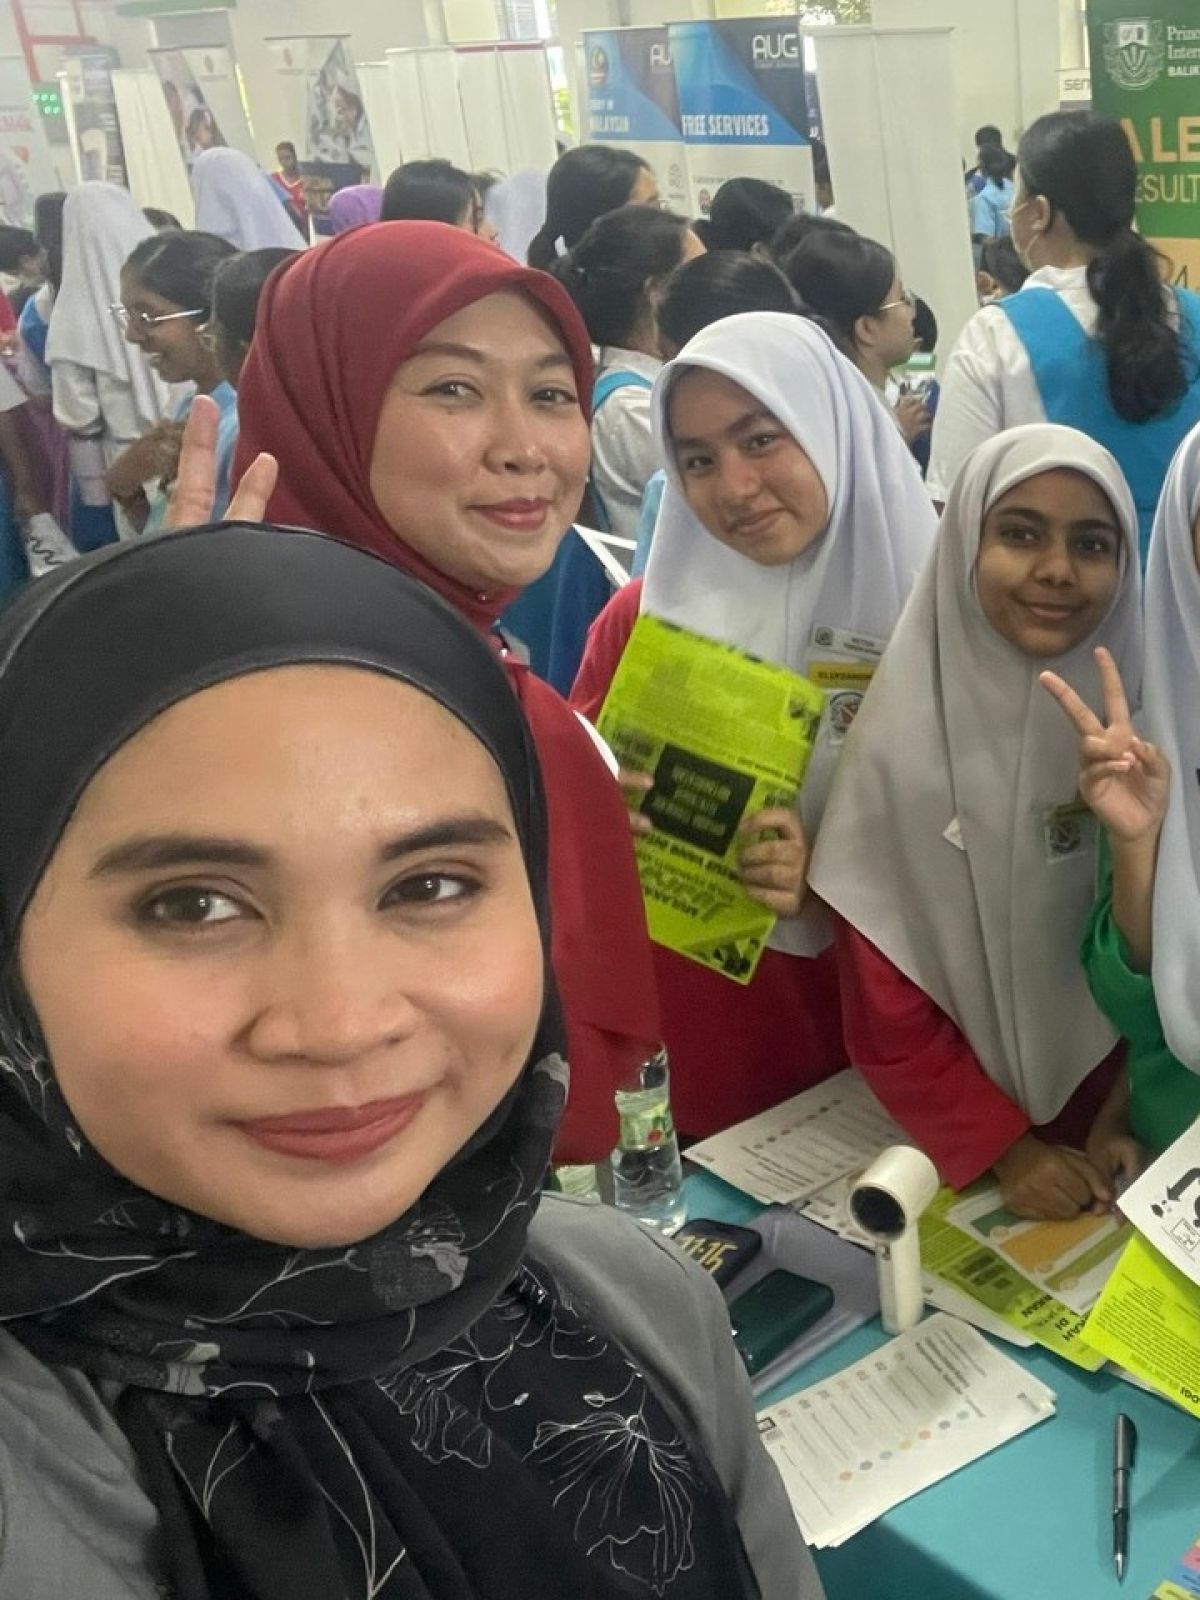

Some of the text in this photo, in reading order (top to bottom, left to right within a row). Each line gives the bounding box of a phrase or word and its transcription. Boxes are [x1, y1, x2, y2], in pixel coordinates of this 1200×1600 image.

[753, 33, 798, 60] AUG
[1167, 66, 1200, 76] BALIK
[708, 114, 770, 136] SERVICES
